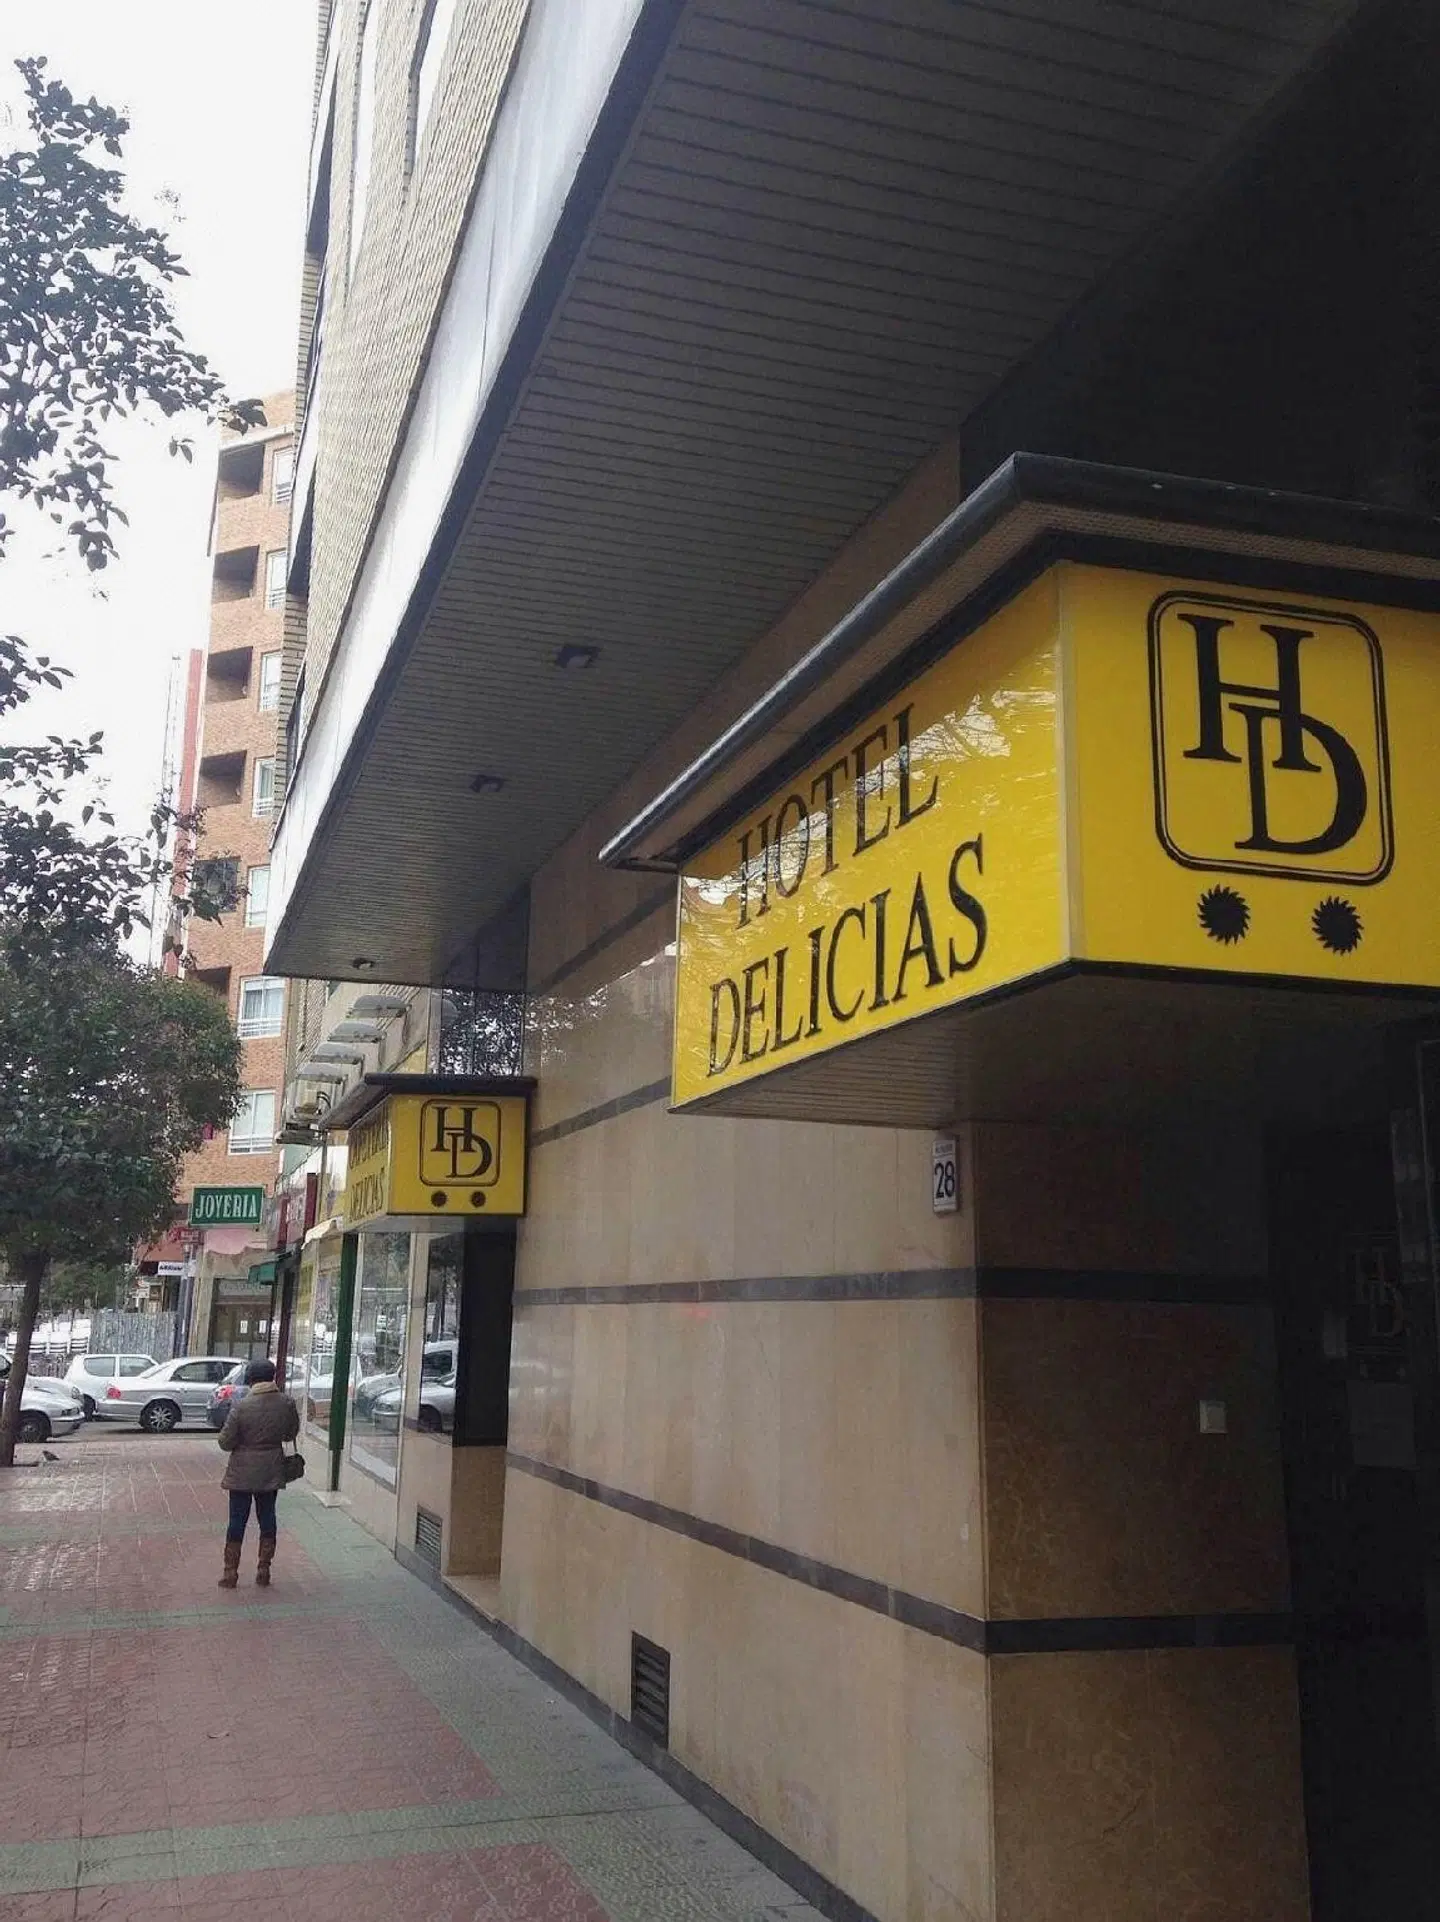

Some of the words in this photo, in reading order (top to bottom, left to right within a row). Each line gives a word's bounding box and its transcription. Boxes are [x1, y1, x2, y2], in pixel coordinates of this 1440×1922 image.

[1176, 612, 1368, 856] HD
[735, 702, 940, 930] HOTEL
[706, 832, 989, 1078] DELICIAS
[194, 1194, 258, 1219] JOYERIA
[430, 1105, 493, 1179] HD
[934, 1160, 955, 1199] 28
